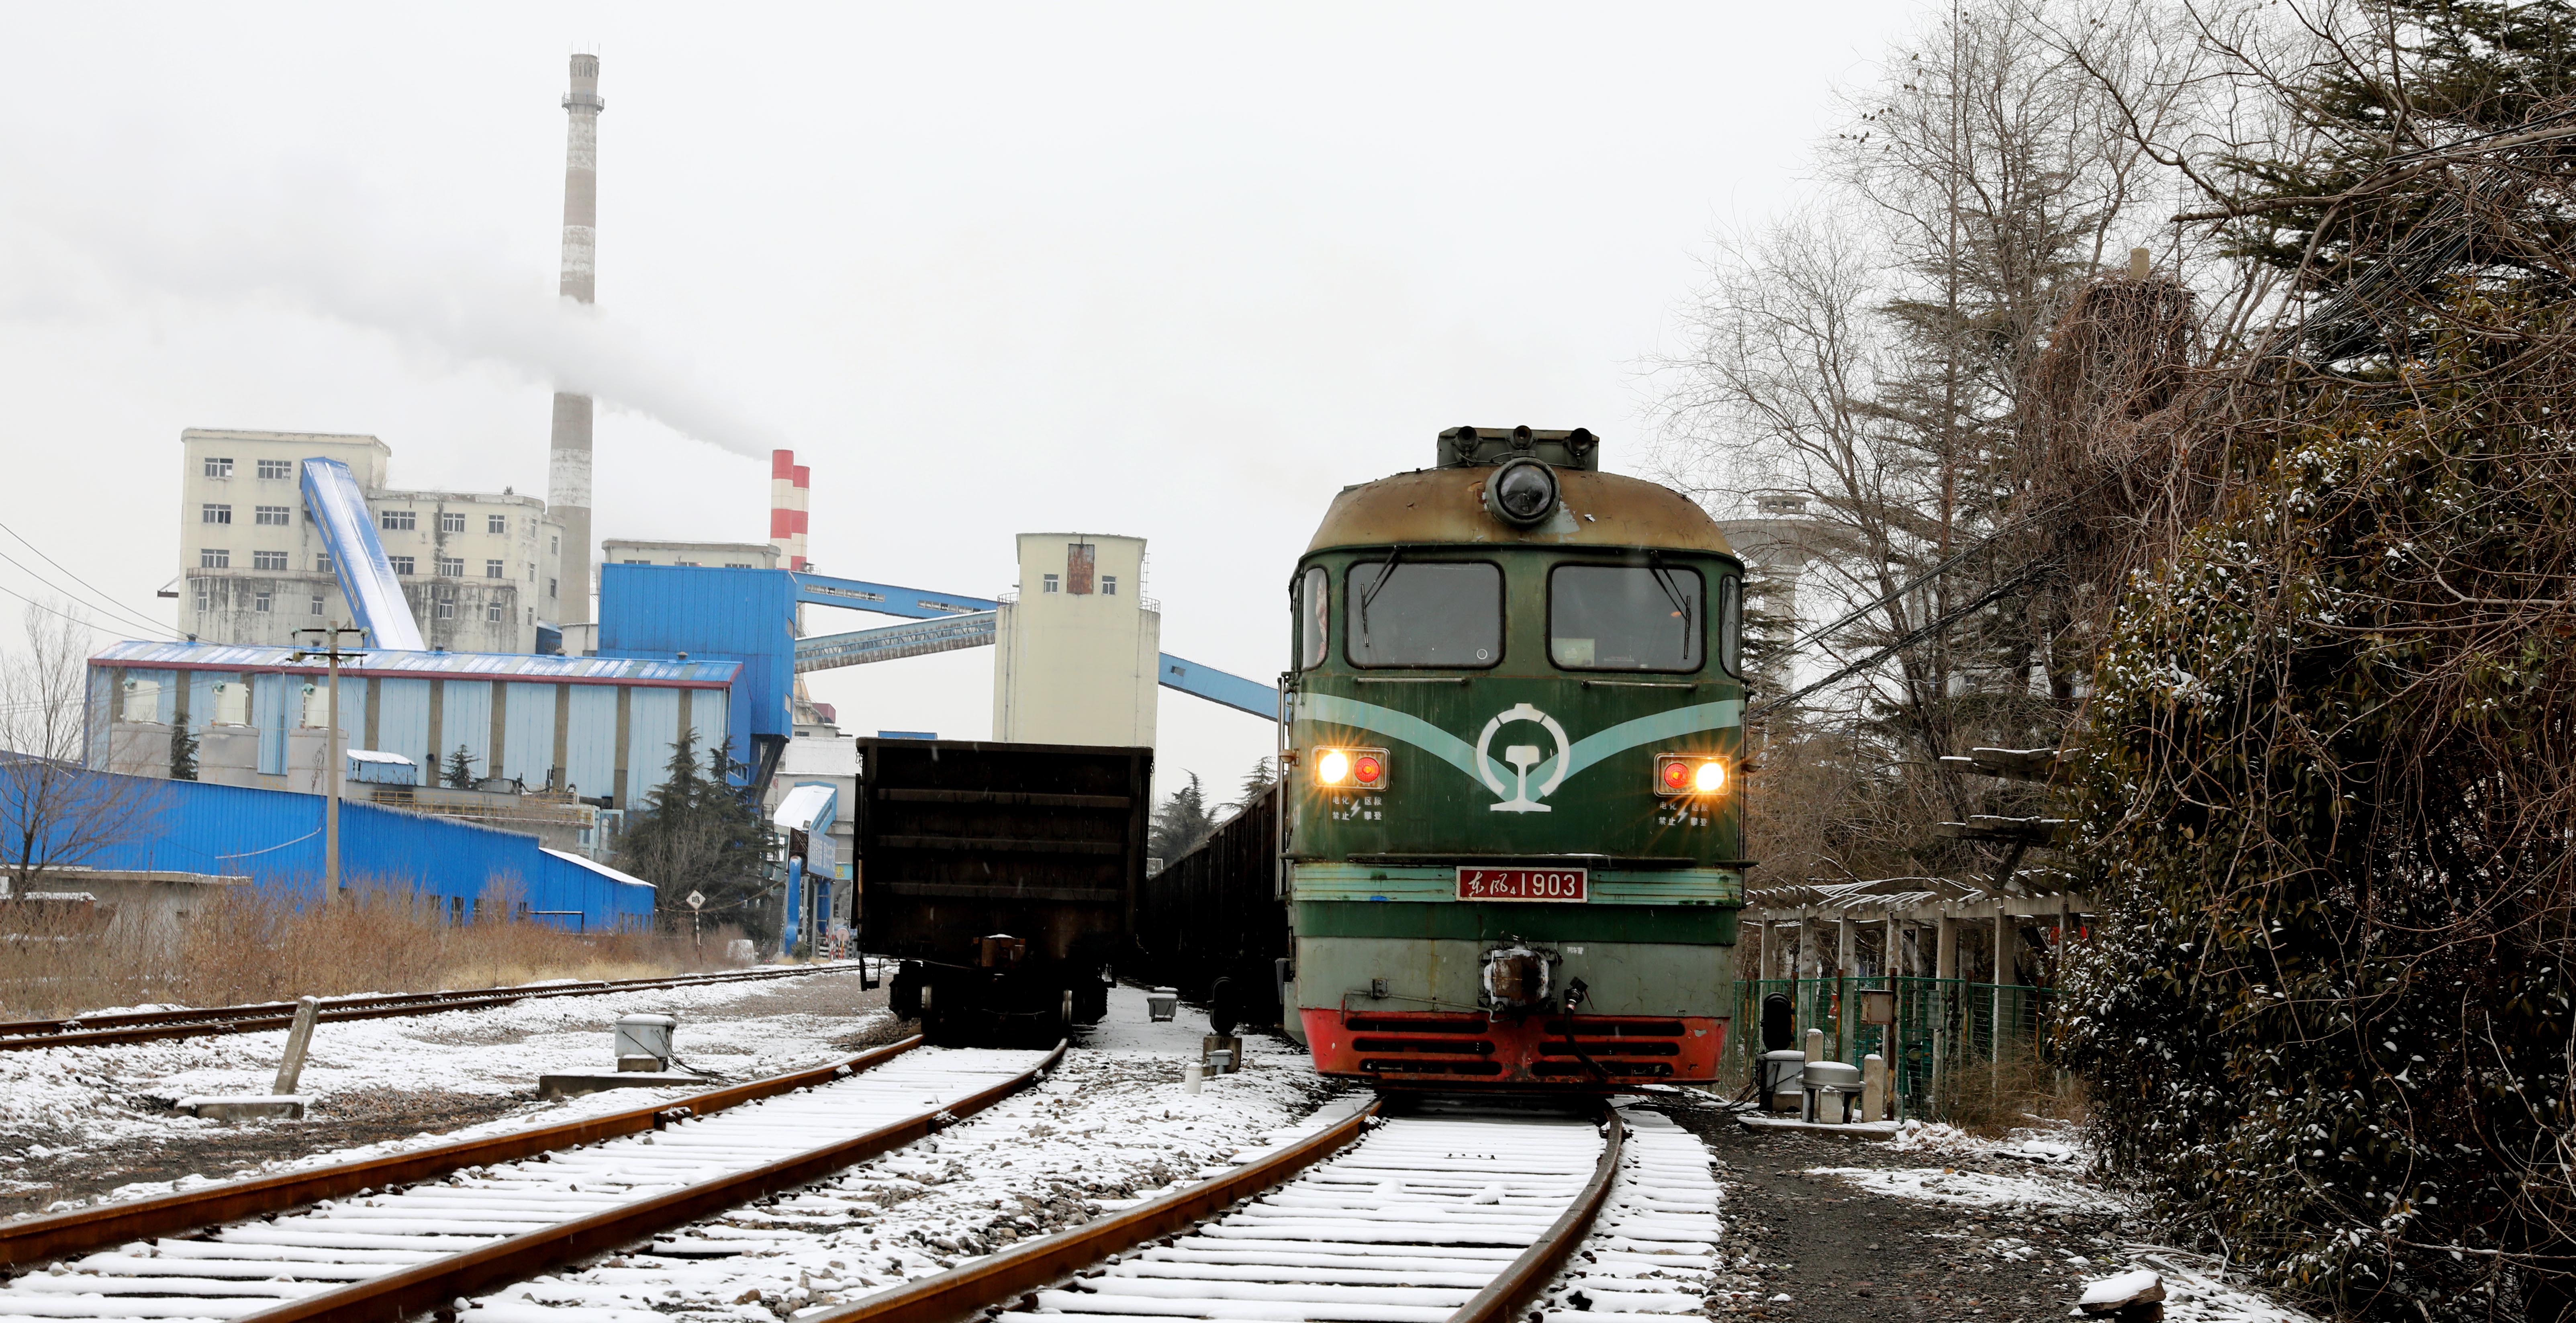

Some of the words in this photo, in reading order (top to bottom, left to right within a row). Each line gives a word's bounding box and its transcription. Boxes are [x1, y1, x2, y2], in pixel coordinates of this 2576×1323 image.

[1332, 796, 1350, 805] 电化
[1365, 797, 1382, 806] 区段
[1659, 801, 1677, 810] 电化
[1332, 811, 1350, 820] 禁止
[1658, 816, 1676, 826] 禁止
[1521, 873, 1575, 896] 1903
